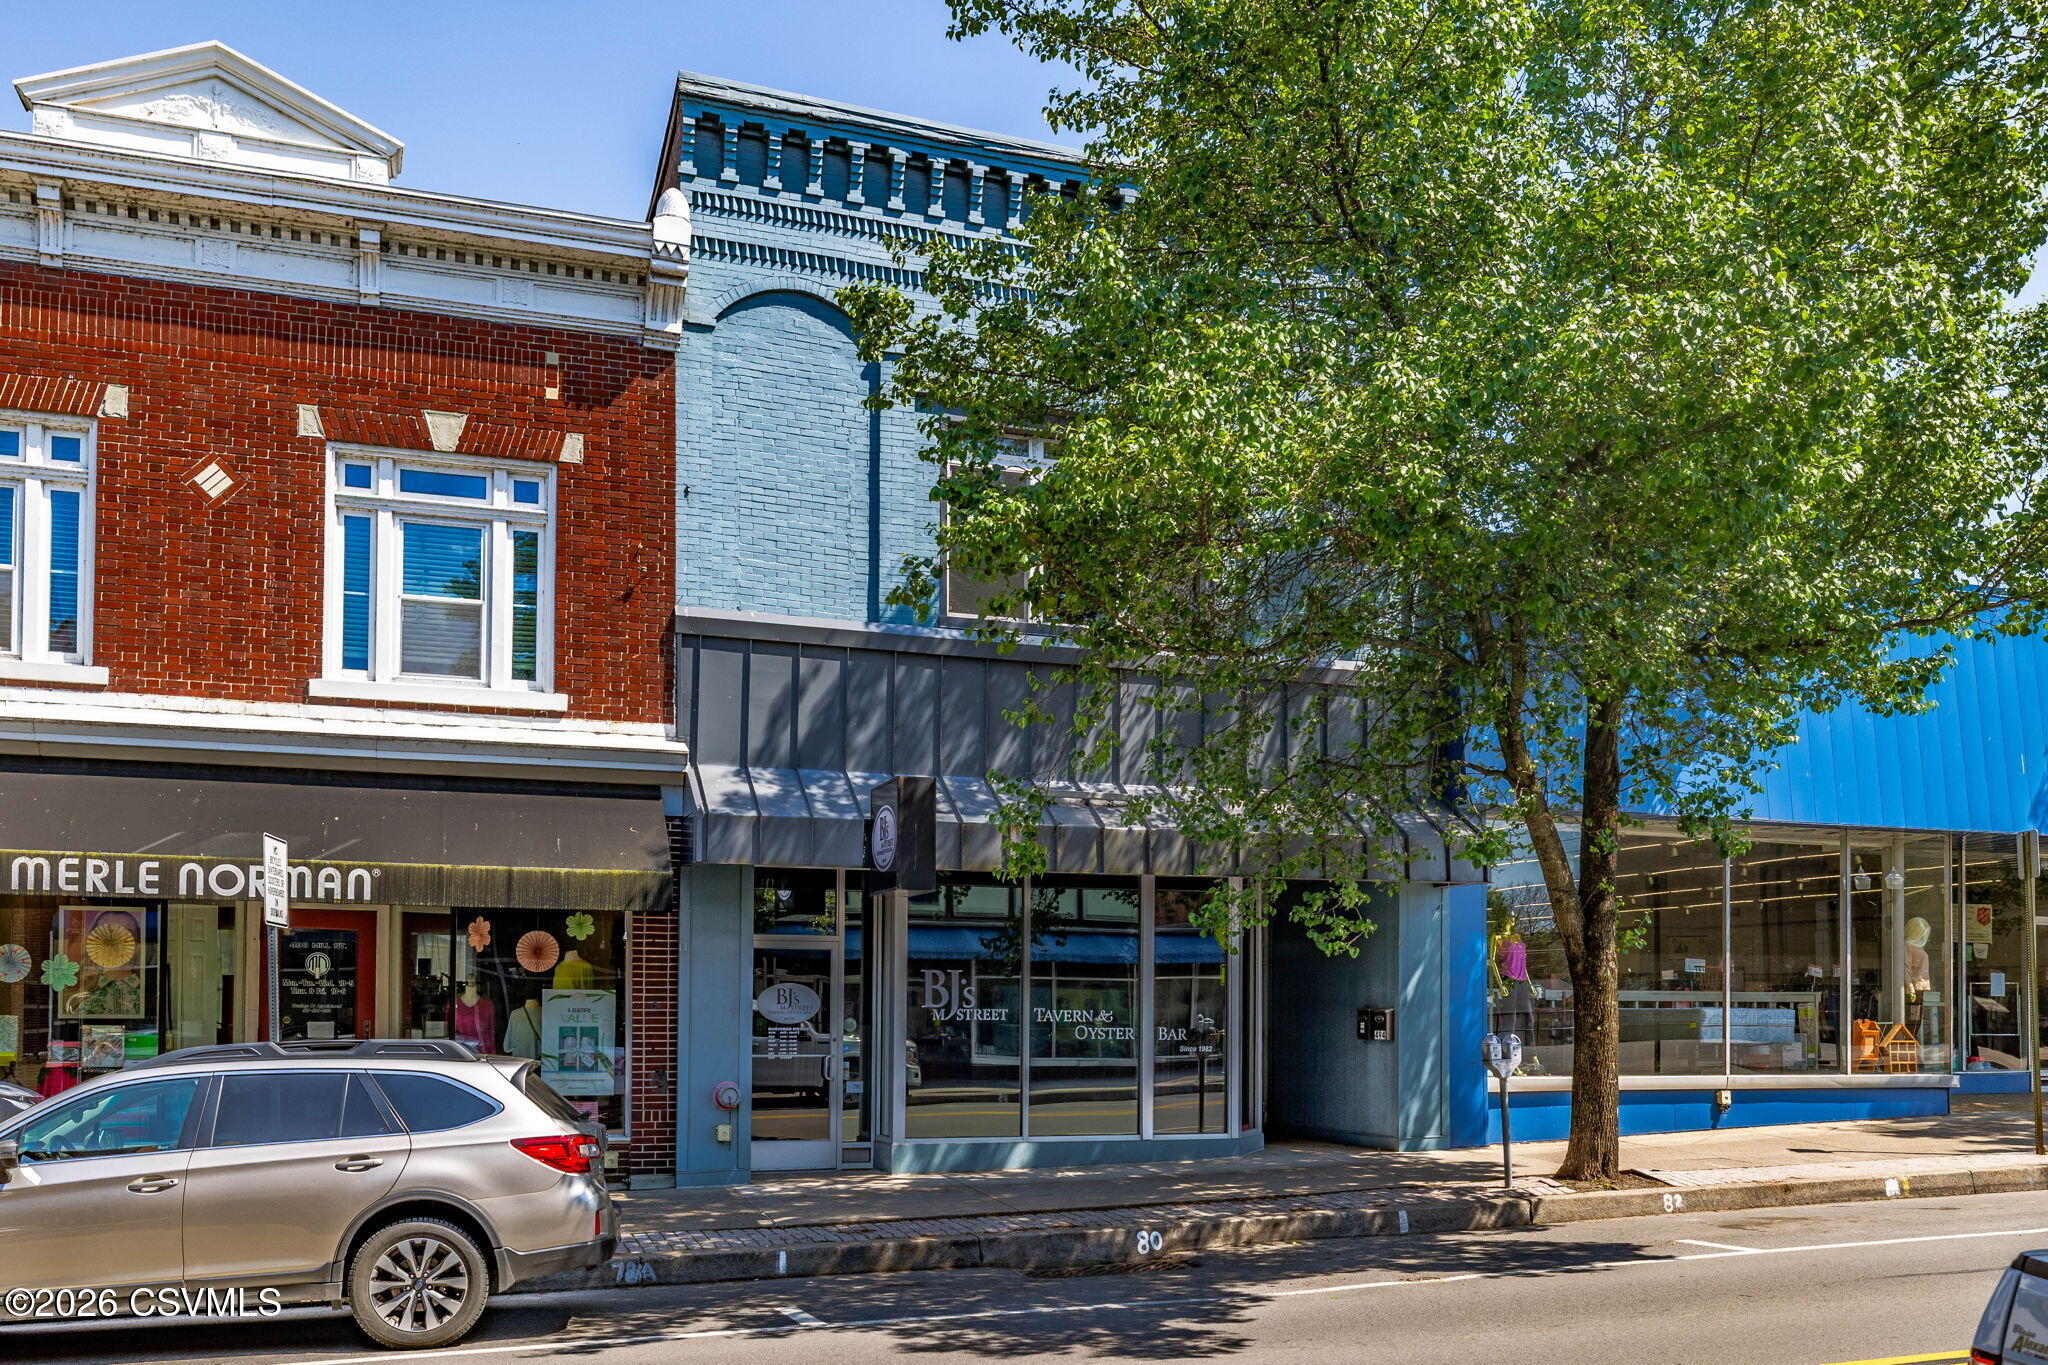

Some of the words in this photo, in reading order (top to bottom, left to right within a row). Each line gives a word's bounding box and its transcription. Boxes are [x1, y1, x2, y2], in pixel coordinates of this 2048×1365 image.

[11, 856, 160, 894] MERLE
[776, 988, 800, 1010] BJ's
[920, 969, 976, 1021] BJ's
[560, 1013, 600, 1023] VALUE
[932, 1008, 946, 1021] M
[956, 1008, 1009, 1021] STREET
[1033, 1008, 1094, 1022] TAVERN
[1097, 1010, 1113, 1022] &
[1075, 1025, 1135, 1040] OYSTER
[1158, 1027, 1188, 1041] BAR
[1137, 1231, 1163, 1255] 80
